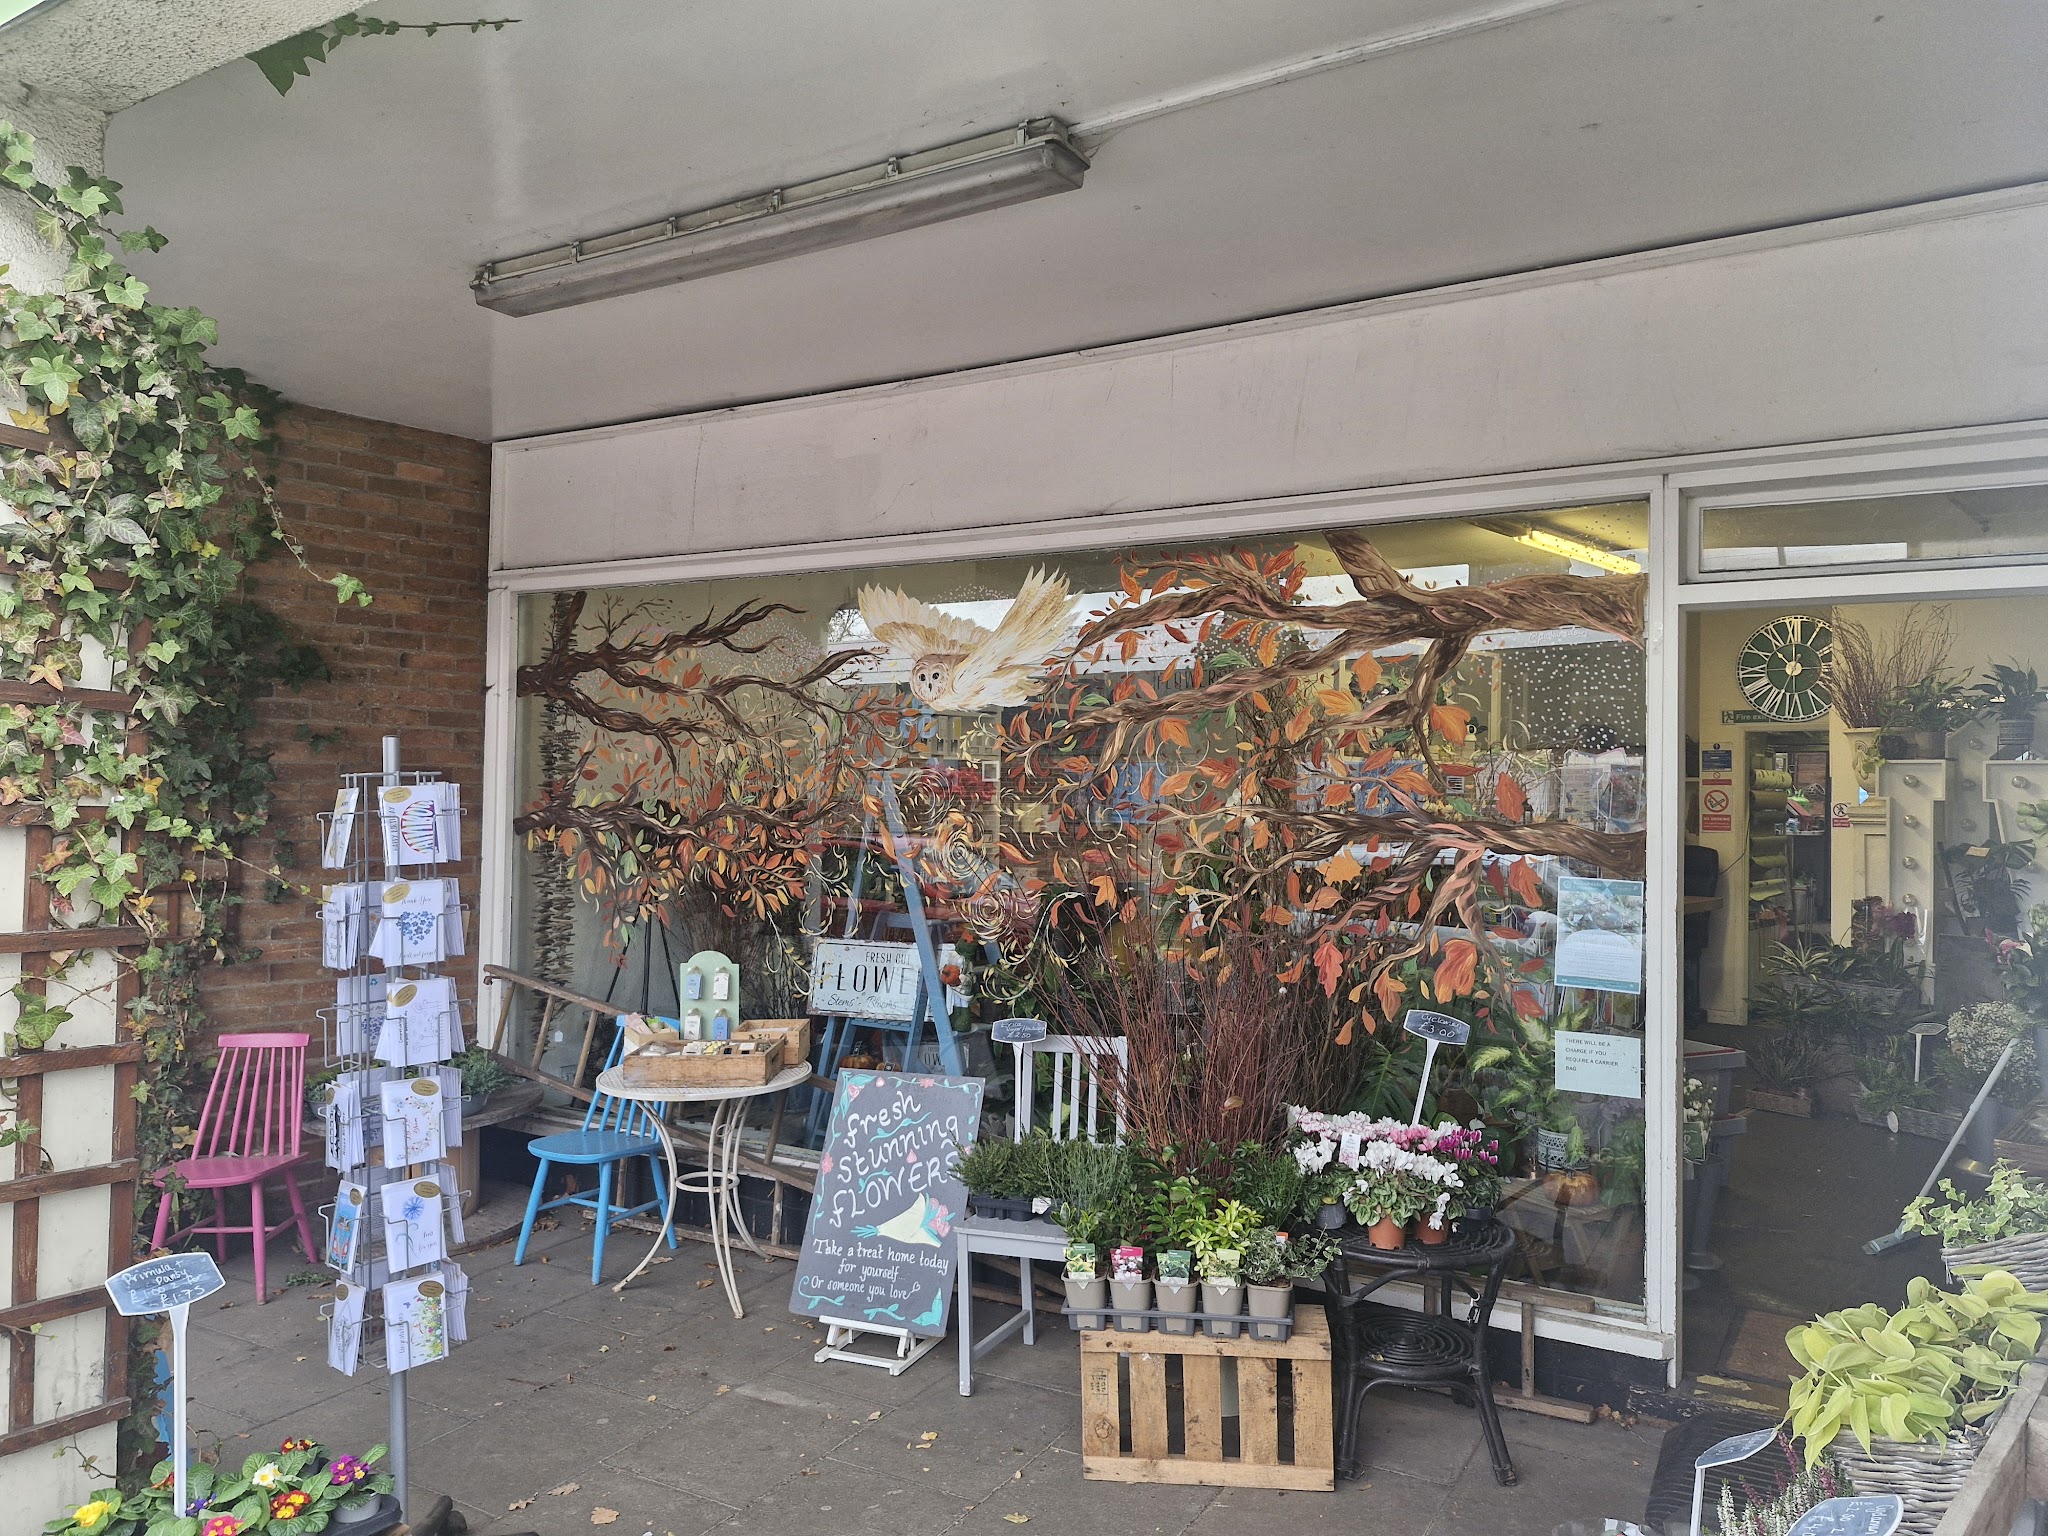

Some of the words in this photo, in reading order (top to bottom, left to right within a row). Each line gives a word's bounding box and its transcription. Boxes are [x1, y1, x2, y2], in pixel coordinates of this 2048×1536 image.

[865, 951, 892, 963] FRESH
[837, 1115, 960, 1184] Stunning
[813, 1238, 843, 1257] Take
[847, 1247, 855, 1257] a
[856, 1242, 884, 1260] treat
[887, 1246, 915, 1265] home
[919, 1252, 949, 1275] today
[838, 1259, 856, 1275] for
[121, 1263, 175, 1285] Primula
[811, 1275, 825, 1288] Or
[827, 1279, 865, 1293] someone
[868, 1284, 886, 1302] you
[889, 1284, 909, 1300] love
